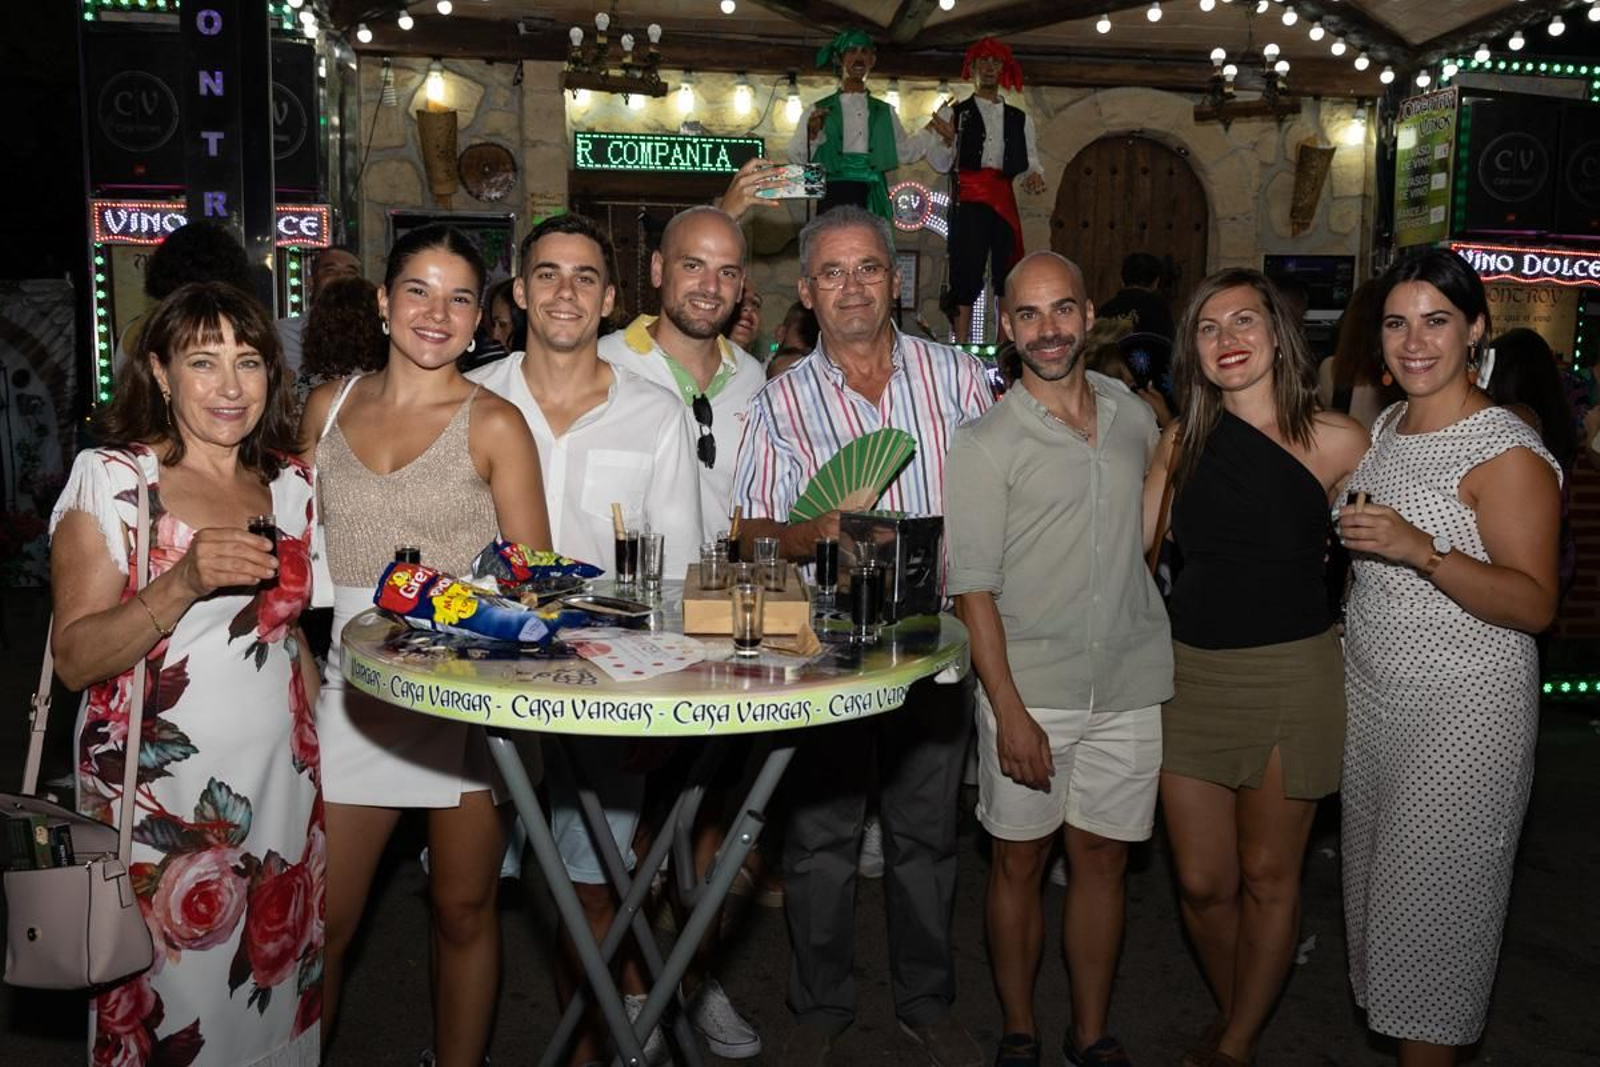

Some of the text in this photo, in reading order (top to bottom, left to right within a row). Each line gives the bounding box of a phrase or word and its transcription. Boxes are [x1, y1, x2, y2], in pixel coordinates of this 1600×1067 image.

[897, 194, 921, 210] CV
[1521, 253, 1600, 278] DULCE
[428, 682, 492, 719] VARGAS
[511, 694, 564, 726] CASA
[571, 698, 653, 727] VARGAS
[672, 700, 730, 730] CASA
[736, 700, 812, 726] VARGAS
[828, 691, 872, 717] CASA
